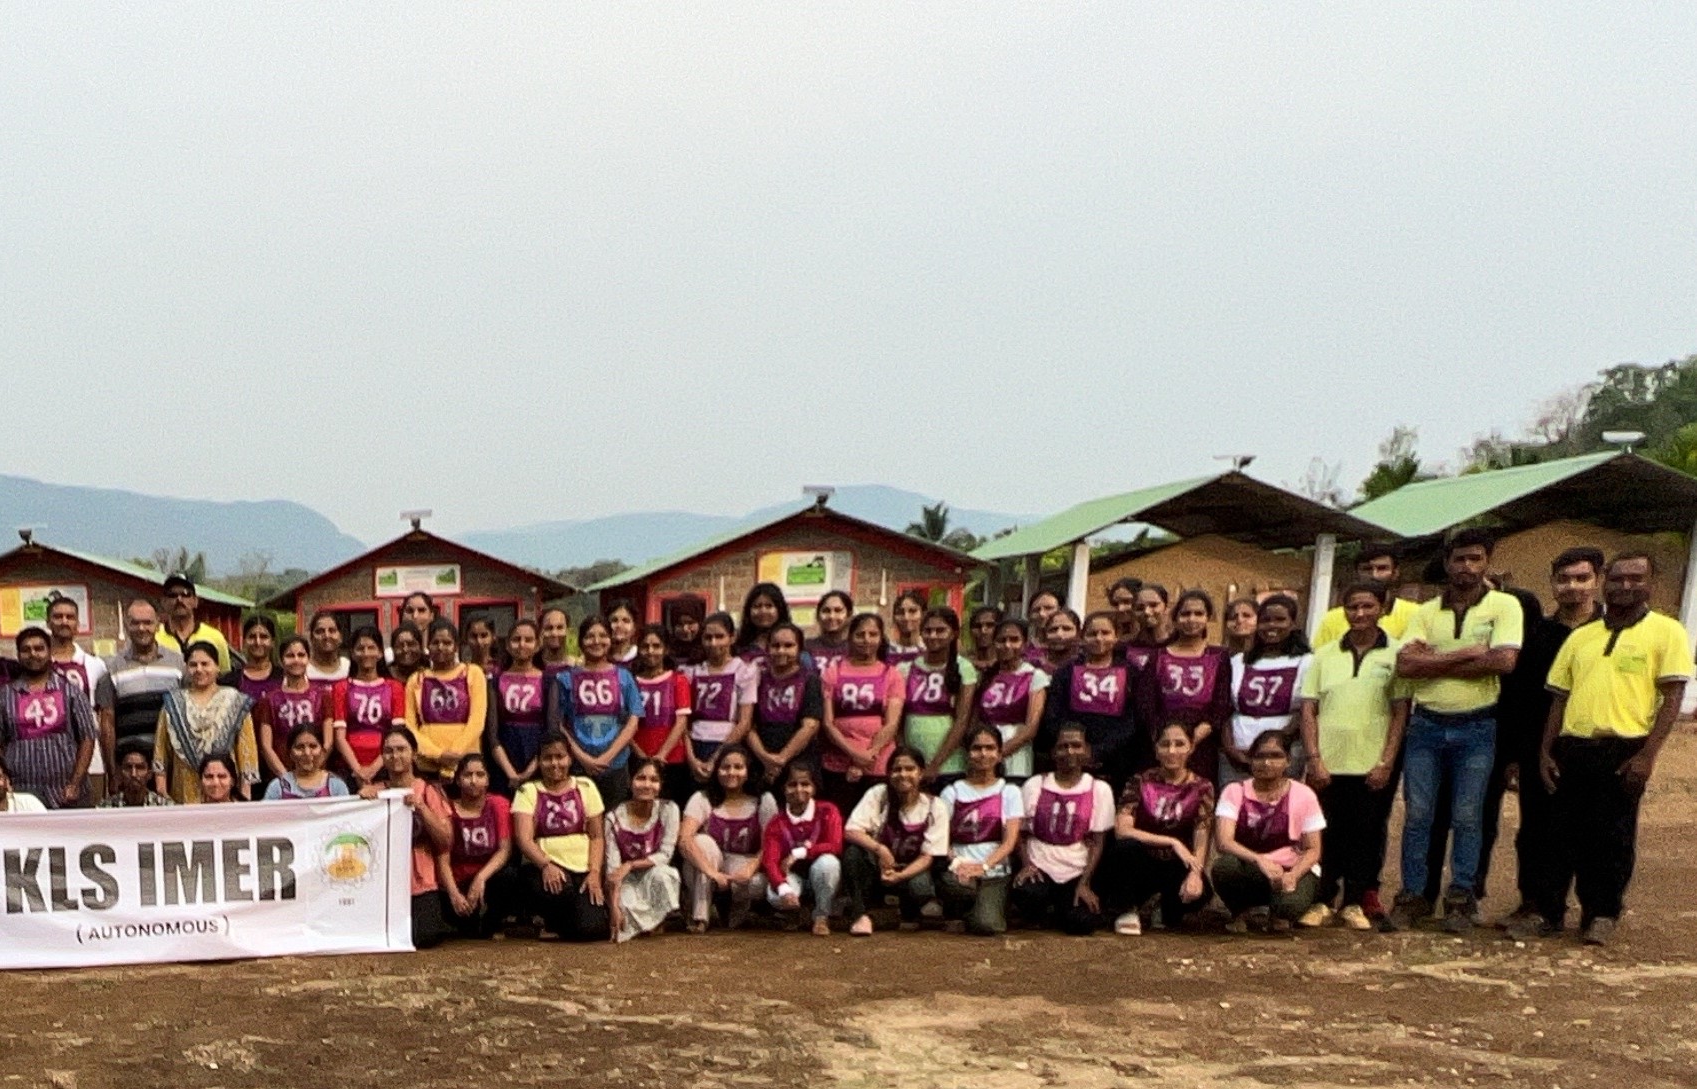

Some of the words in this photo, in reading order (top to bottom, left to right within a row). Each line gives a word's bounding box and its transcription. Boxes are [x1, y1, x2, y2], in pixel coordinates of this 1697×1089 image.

[578, 679, 614, 706] 66
[1079, 672, 1119, 703] 34
[1161, 664, 1204, 697] 33
[1246, 676, 1283, 706] 57
[355, 694, 383, 723] 76
[697, 682, 724, 712] 72
[23, 699, 59, 728] 43
[278, 701, 313, 728] 48
[4, 842, 120, 915] KLS
[138, 836, 296, 906] IMER
